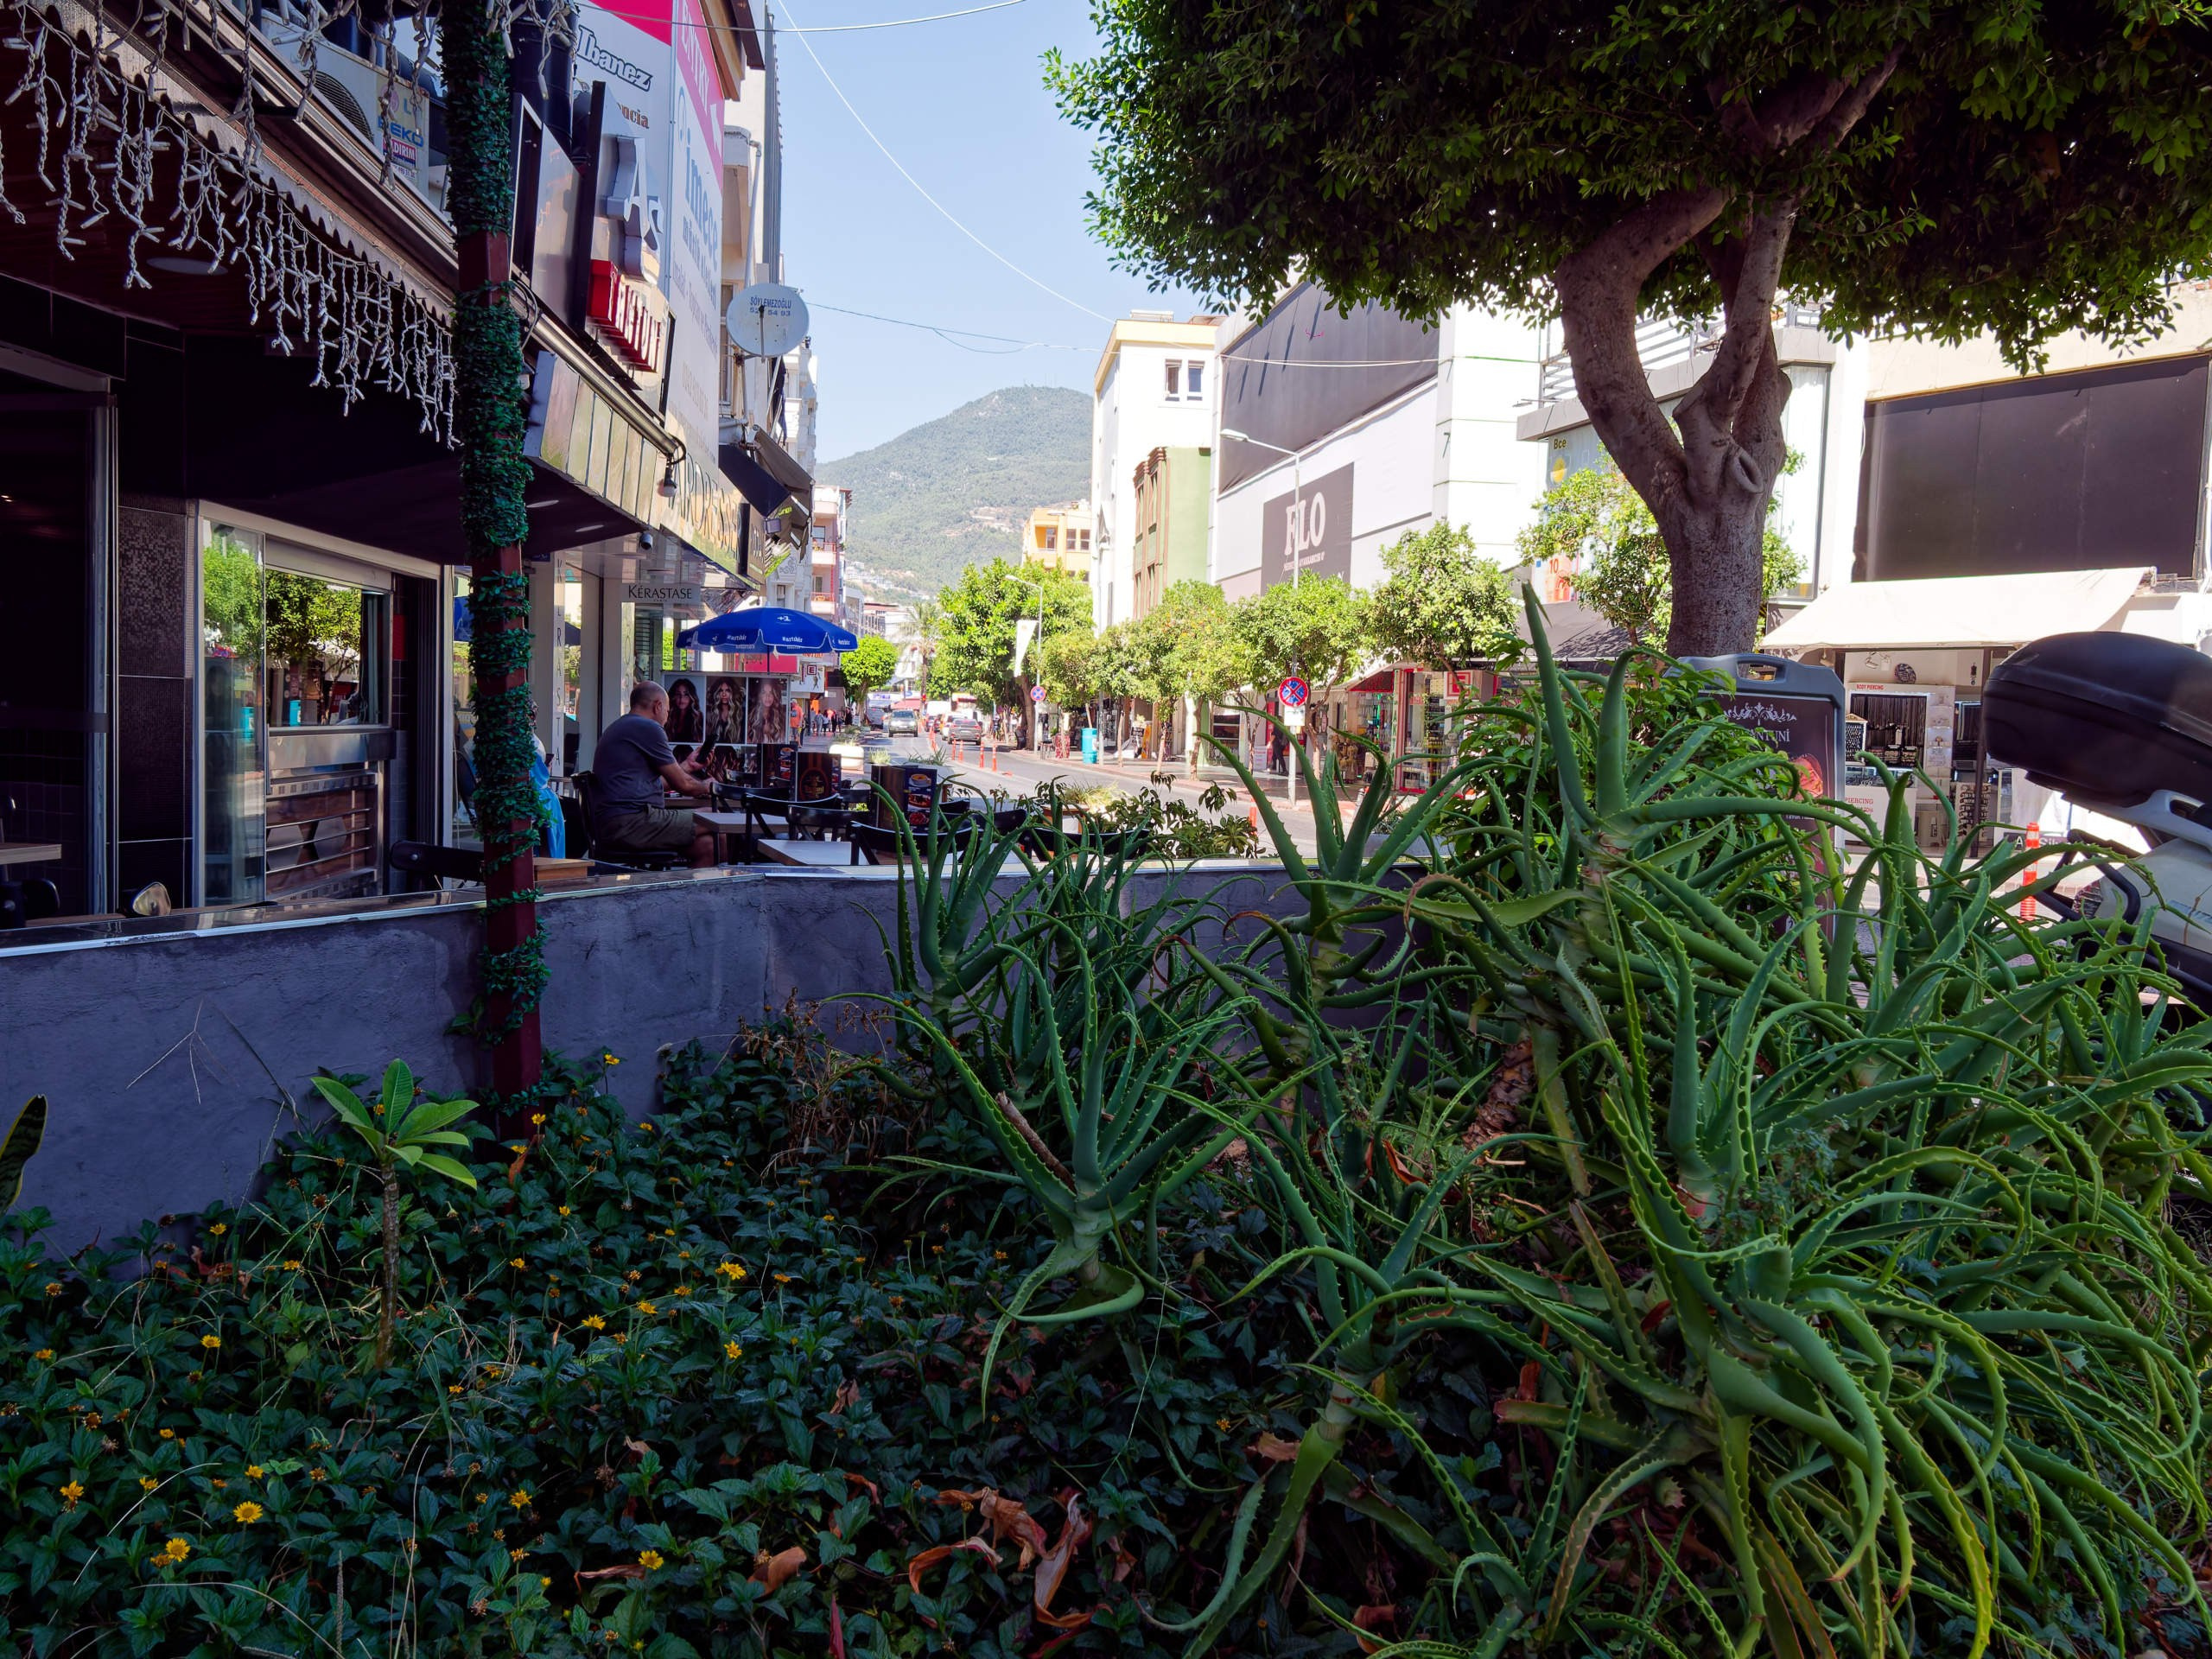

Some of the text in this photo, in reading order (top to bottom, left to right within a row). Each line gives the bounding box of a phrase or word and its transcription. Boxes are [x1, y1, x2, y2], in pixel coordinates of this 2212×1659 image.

[577, 25, 653, 92] Ibanez
[618, 103, 650, 129] ncia
[685, 128, 718, 272] imece
[1554, 438, 1567, 449] Все
[1284, 492, 1325, 556] FLO
[1549, 558, 1559, 574] 10
[629, 585, 692, 599] KÉRASTASE
